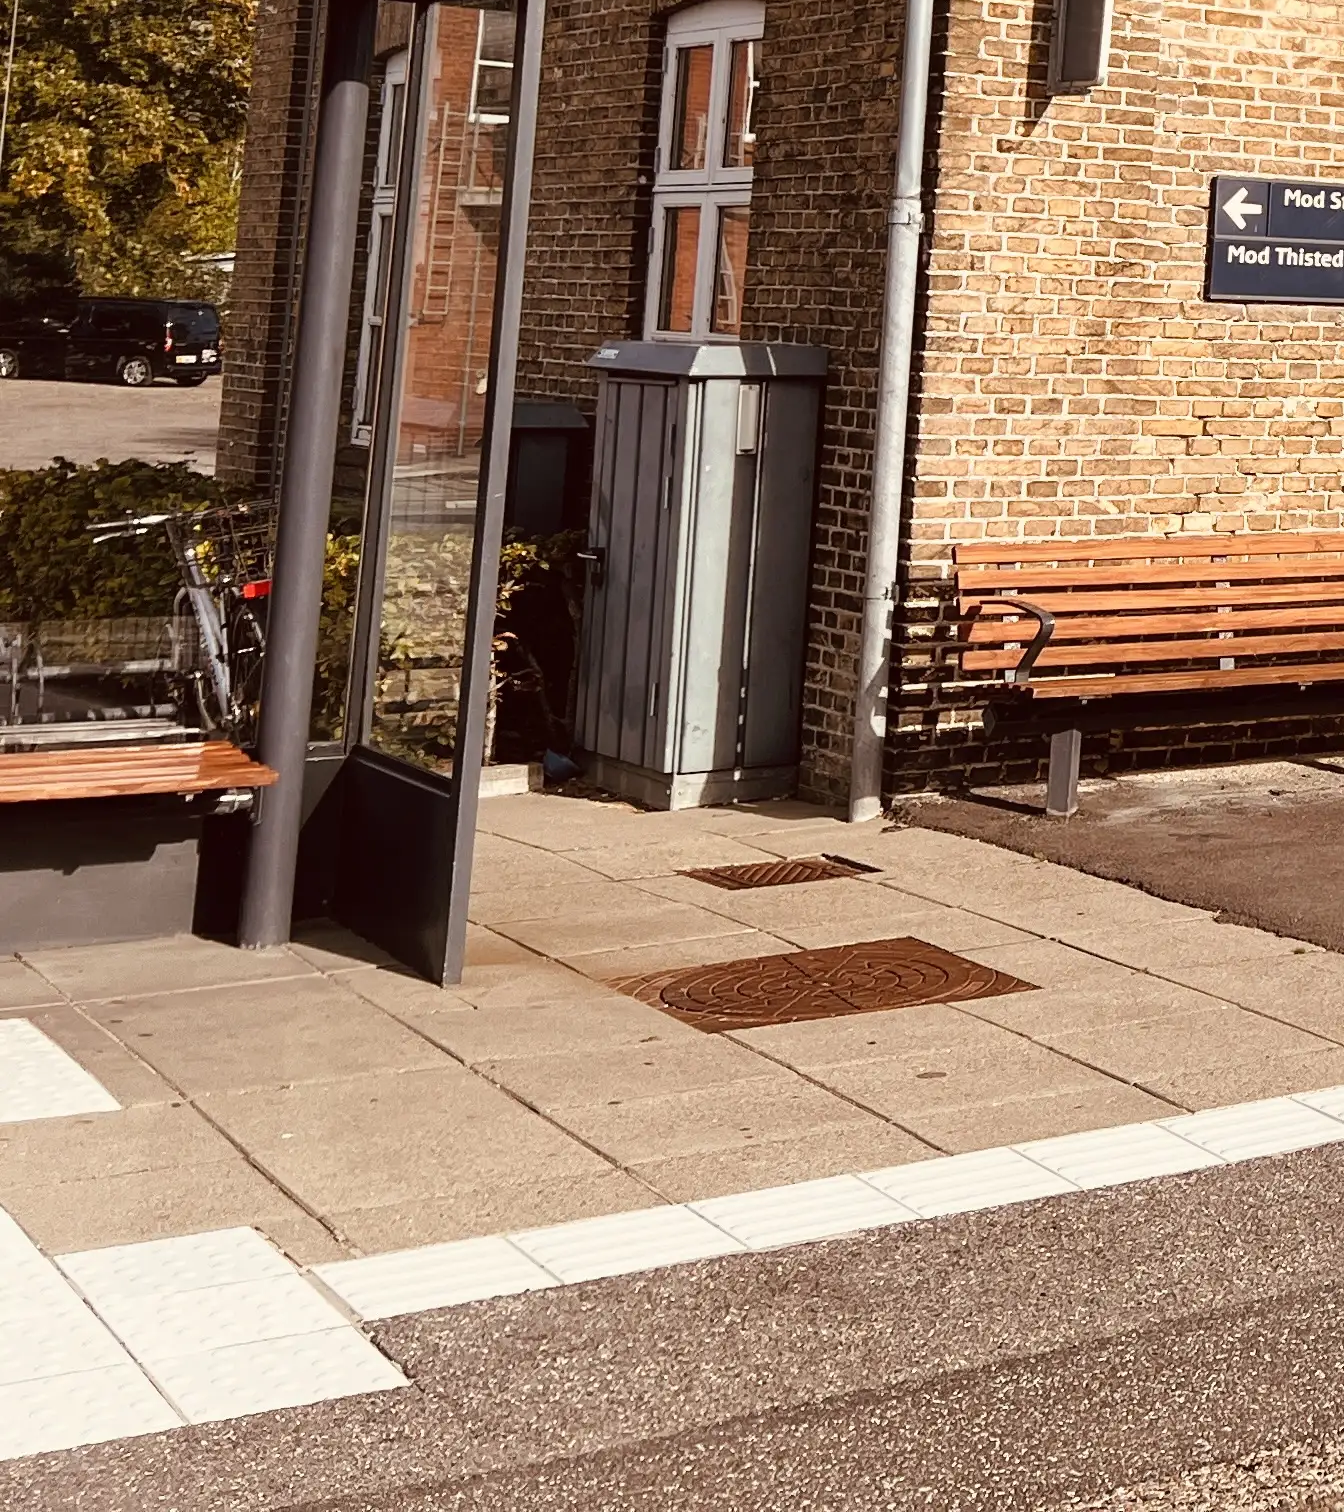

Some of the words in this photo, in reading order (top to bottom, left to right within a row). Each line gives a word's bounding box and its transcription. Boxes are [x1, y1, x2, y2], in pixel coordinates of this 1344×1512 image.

[1283, 188, 1326, 210] Mod
[1227, 245, 1270, 266] Mod
[1275, 246, 1344, 268] Thisted
